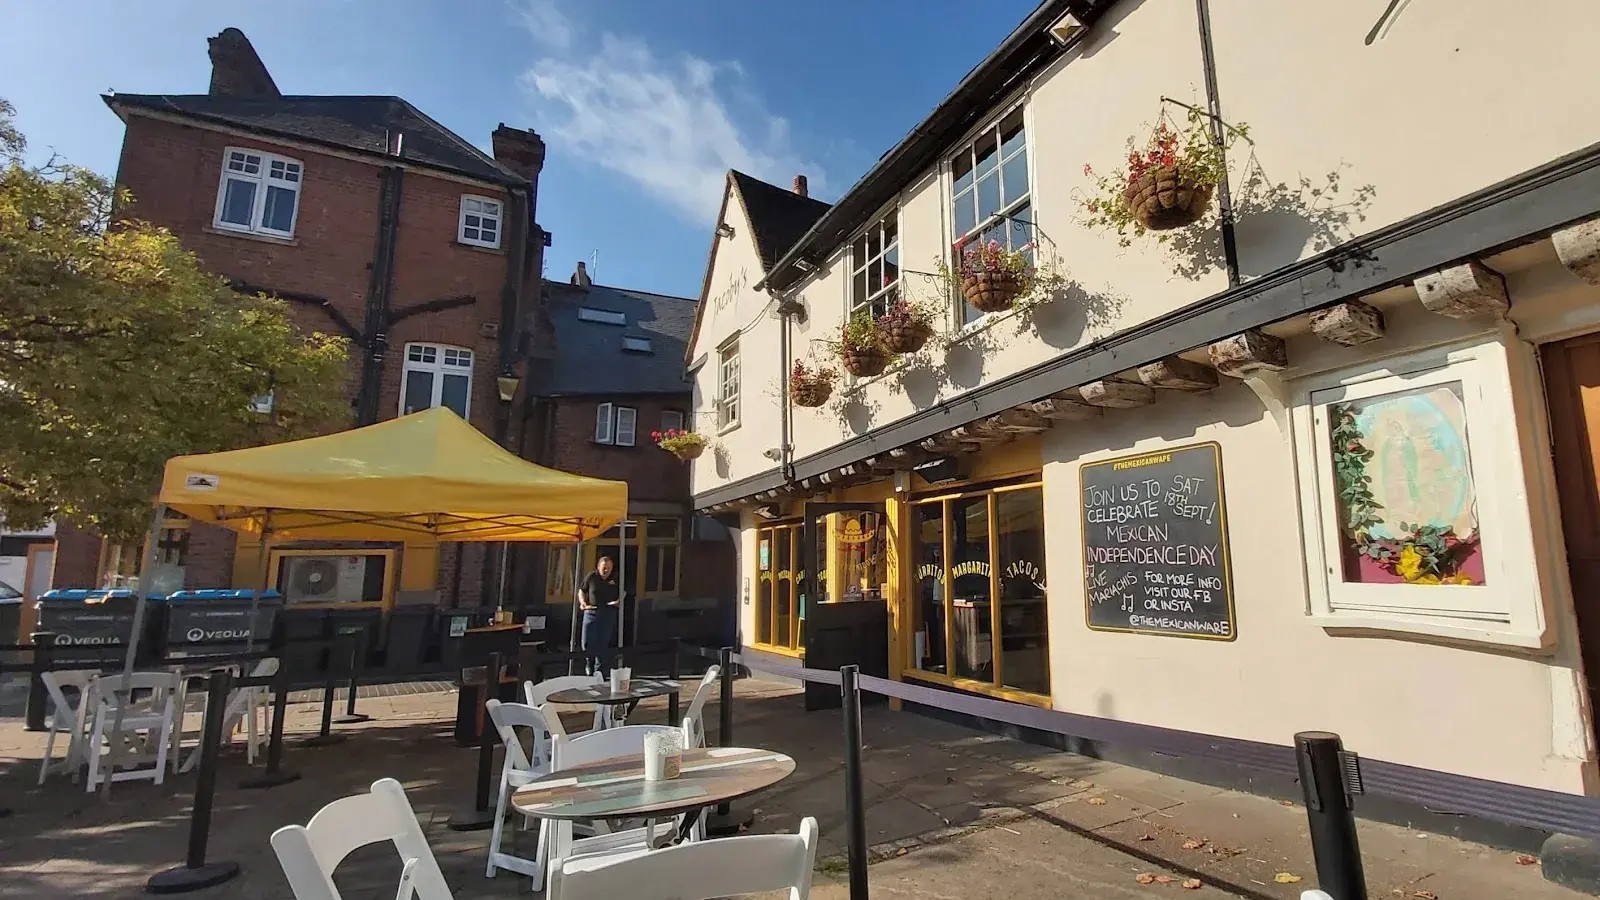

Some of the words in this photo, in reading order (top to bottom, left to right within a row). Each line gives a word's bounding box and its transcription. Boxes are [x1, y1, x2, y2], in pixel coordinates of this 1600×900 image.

[1085, 484, 1115, 508] JOIN
[1120, 483, 1139, 501] US
[1142, 479, 1161, 497] TO
[1170, 475, 1205, 495] SAT
[1164, 490, 1188, 505] 18TH
[1088, 500, 1159, 524] CELEBRATE
[1173, 502, 1216, 525] SEPT!
[1107, 523, 1168, 542] MEXICAN
[1087, 545, 1186, 565] INDEPENDENCE
[1189, 543, 1219, 567] DAY
[1006, 559, 1039, 580] TACOS
[1087, 569, 1107, 590] LIVE
[1089, 572, 1138, 607] MARIACHIS
[1144, 571, 1163, 583] FOR
[1166, 573, 1194, 586] MORE
[1198, 576, 1222, 590] INFO
[1144, 586, 1170, 597] VISIT
[1170, 587, 1192, 600] OUR
[1193, 590, 1211, 603] FB
[1144, 599, 1160, 610] OR
[1161, 600, 1194, 613] INSTA
[1129, 614, 1229, 634] @THEMEXICANWARE
[206, 630, 251, 639] VEOLIA
